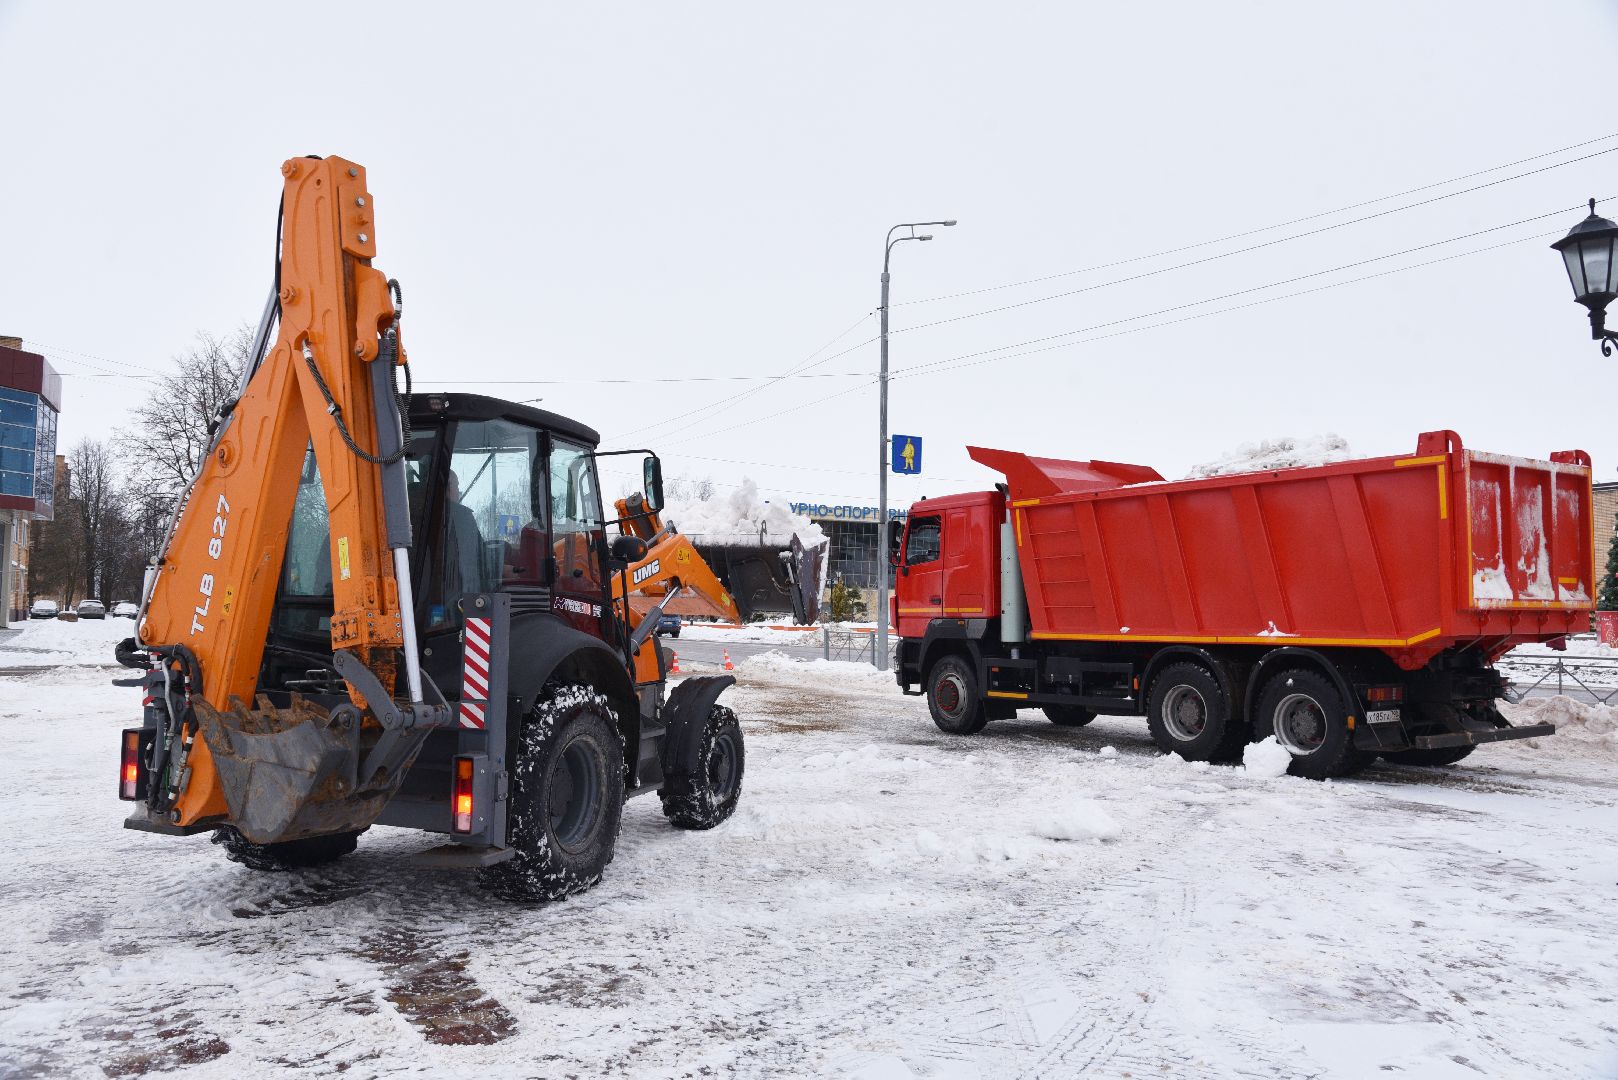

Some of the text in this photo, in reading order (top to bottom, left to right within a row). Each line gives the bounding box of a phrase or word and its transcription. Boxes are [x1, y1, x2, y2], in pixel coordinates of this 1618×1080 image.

[789, 502, 909, 521] УРНО-СПОРТВН
[190, 493, 230, 636] TLB 827
[633, 560, 660, 584] UMG
